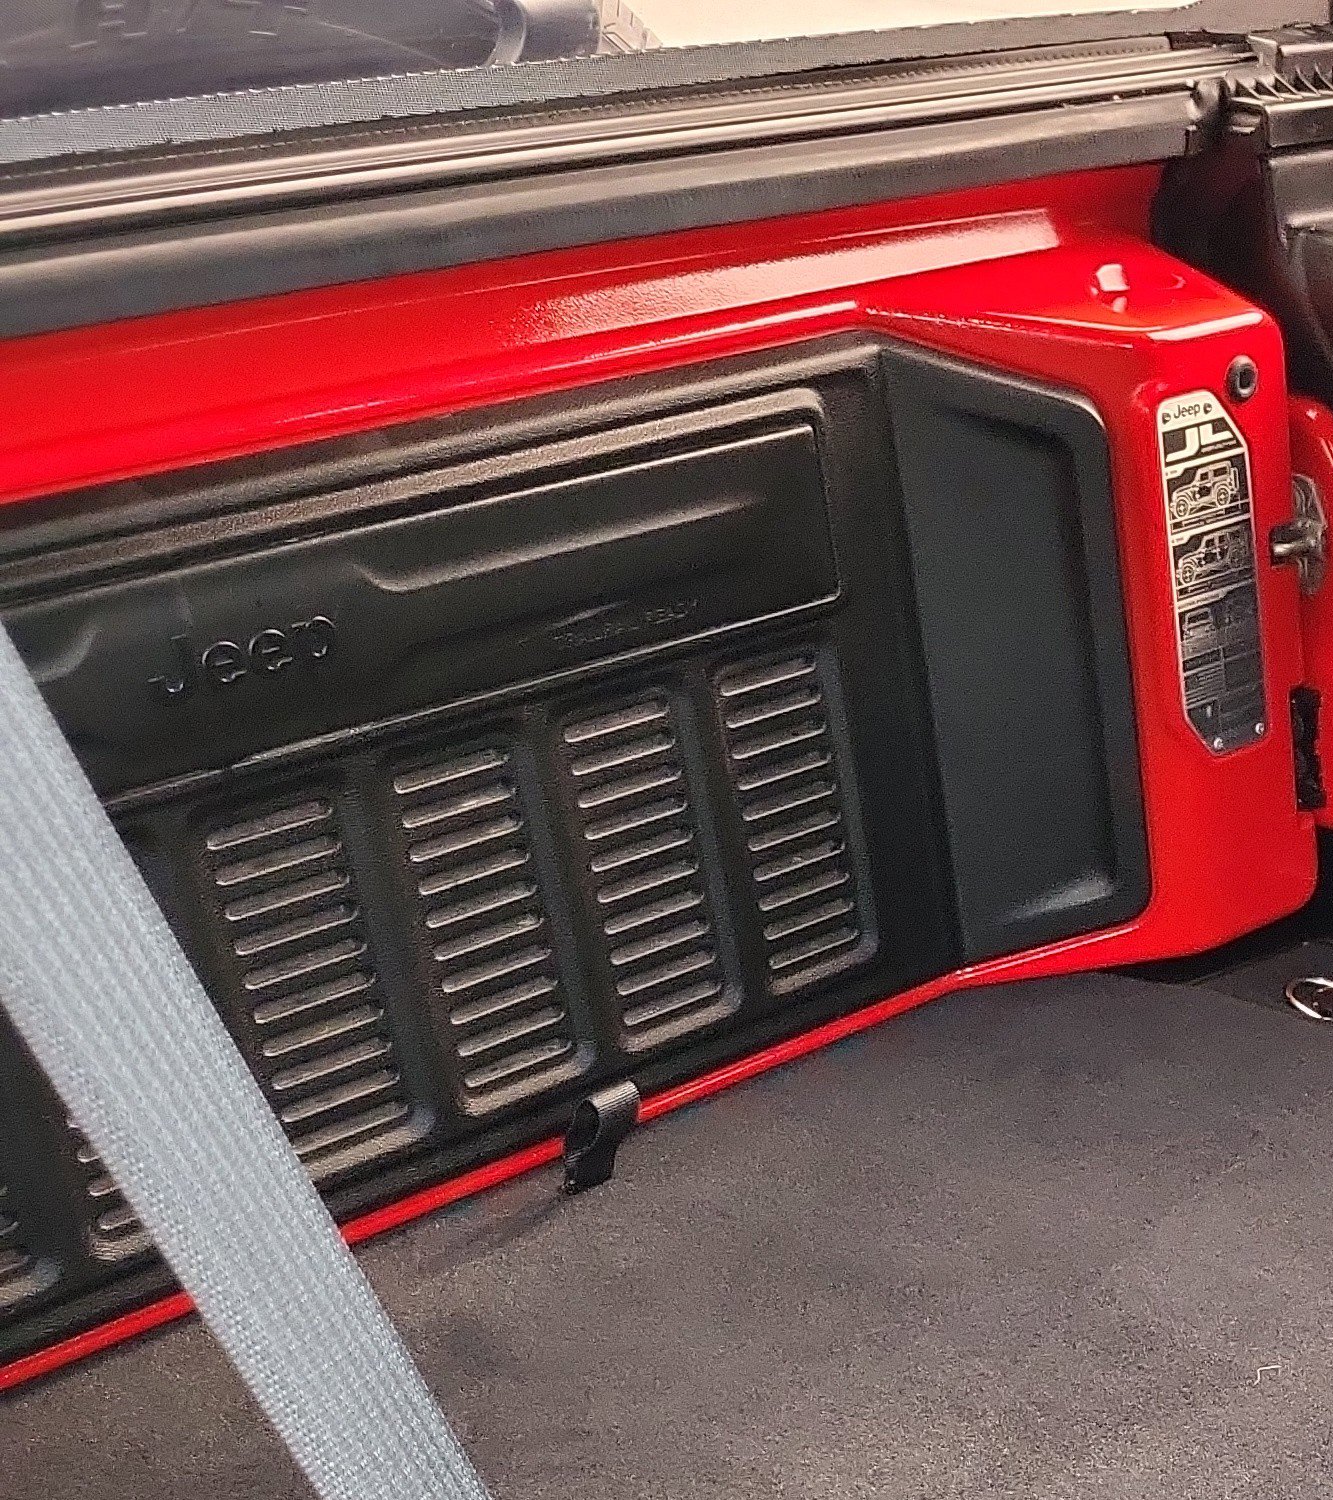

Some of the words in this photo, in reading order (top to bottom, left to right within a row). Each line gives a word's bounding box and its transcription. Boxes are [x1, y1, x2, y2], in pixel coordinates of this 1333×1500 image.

[1173, 403, 1201, 419] Jeep
[1165, 422, 1234, 463] JL
[147, 614, 337, 694] Jeep
